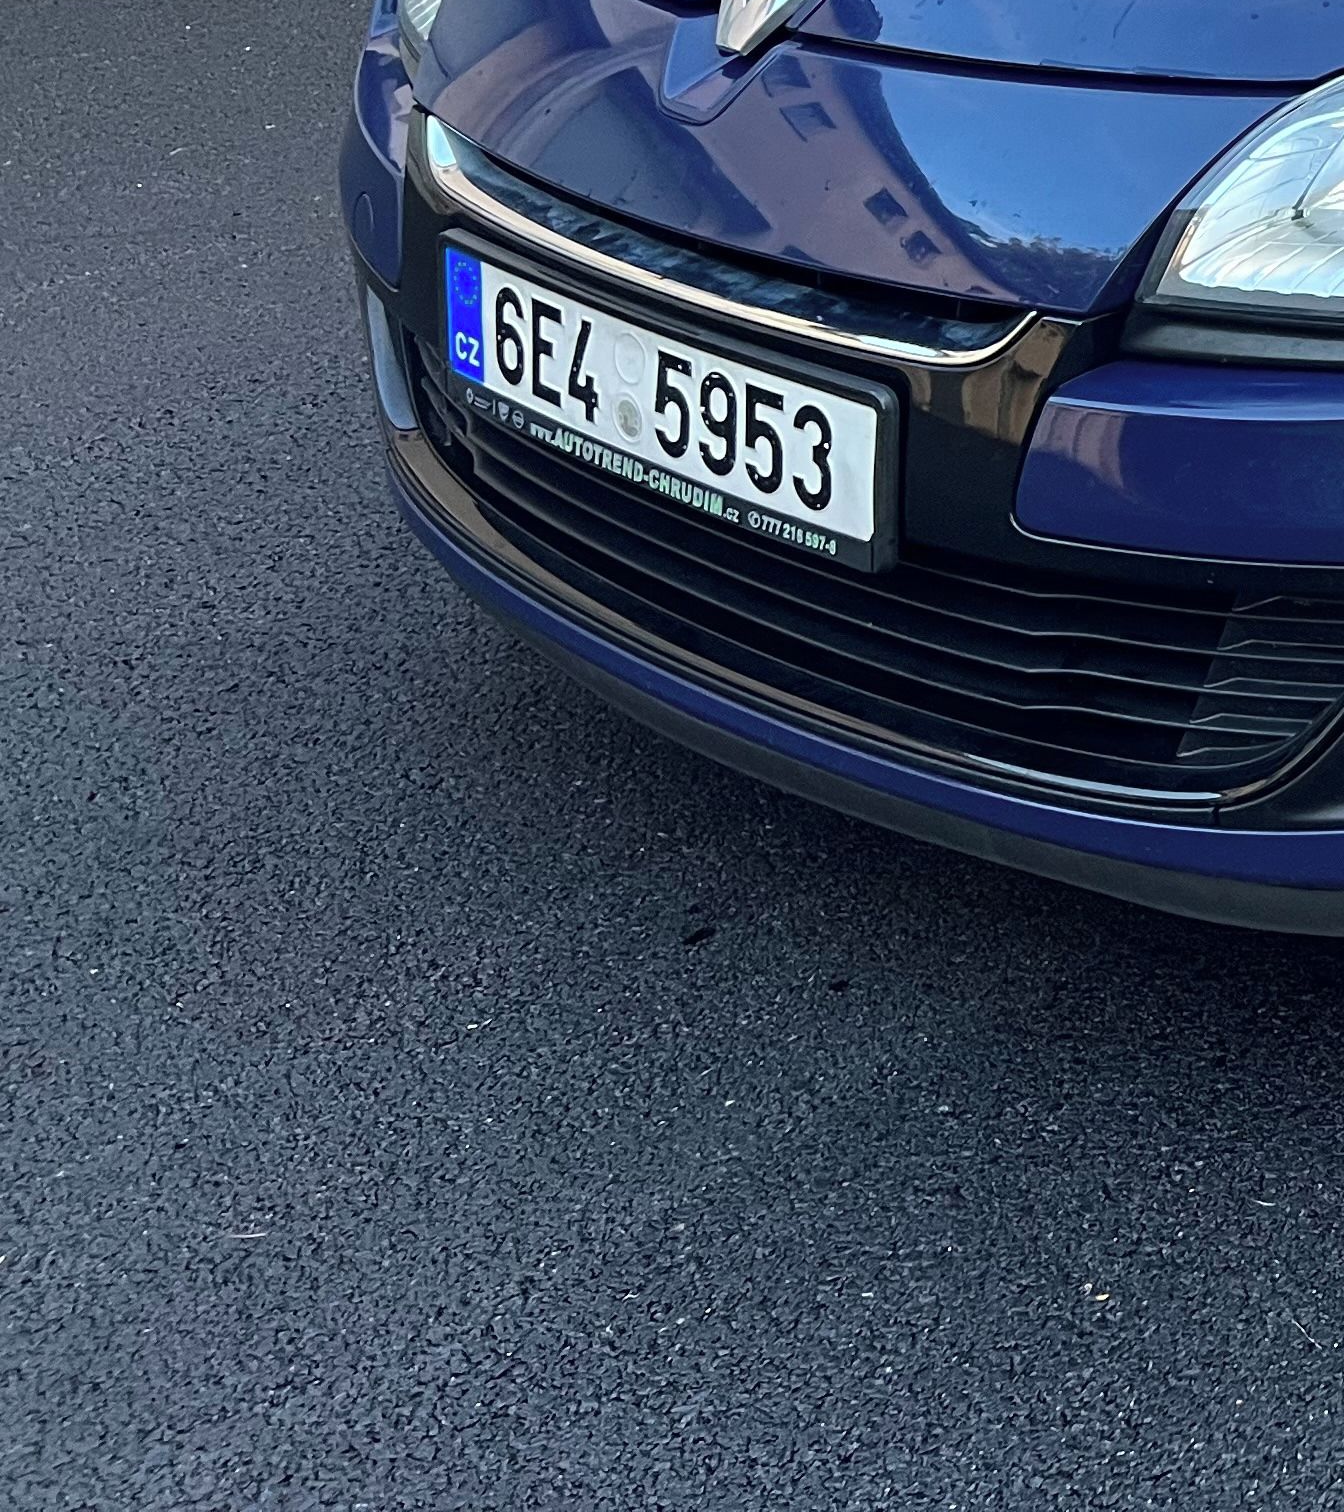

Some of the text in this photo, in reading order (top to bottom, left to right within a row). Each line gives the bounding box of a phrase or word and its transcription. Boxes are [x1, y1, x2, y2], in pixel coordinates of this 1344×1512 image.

[455, 332, 480, 367] CZ
[495, 287, 832, 510] 6E4 5953
